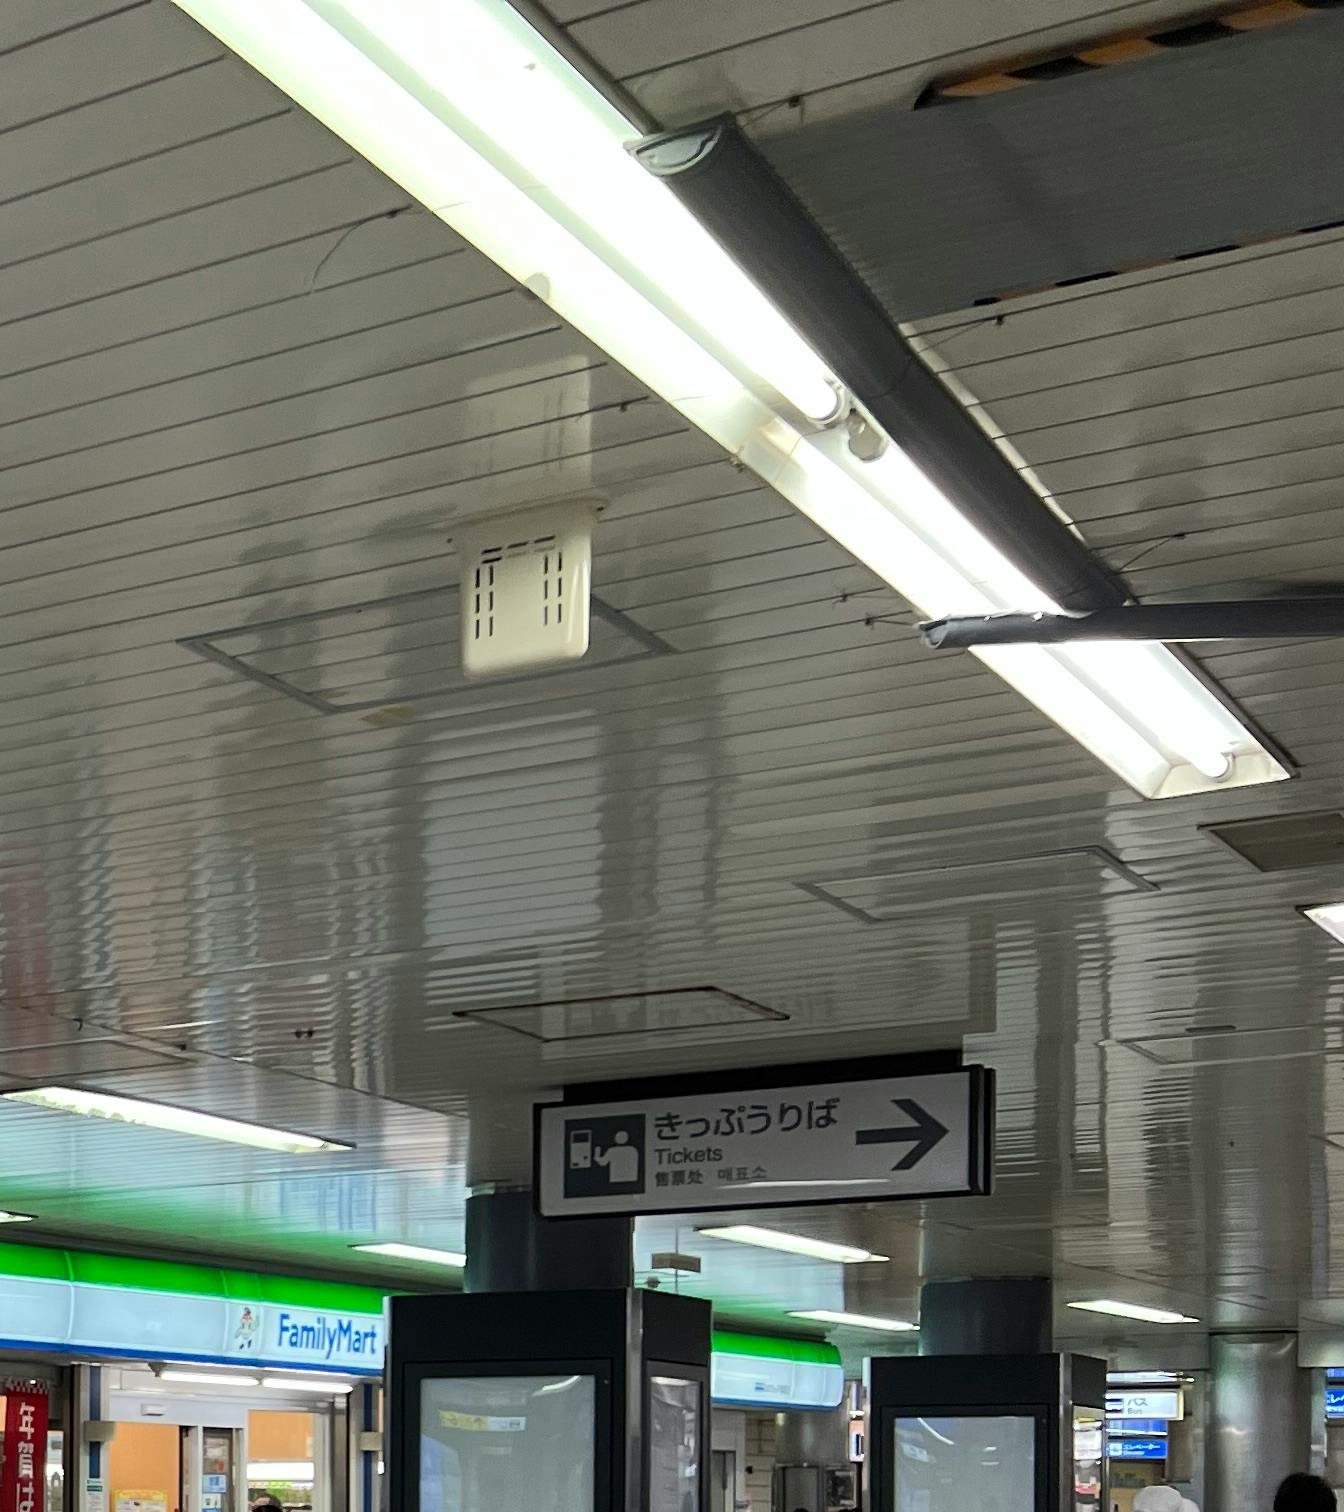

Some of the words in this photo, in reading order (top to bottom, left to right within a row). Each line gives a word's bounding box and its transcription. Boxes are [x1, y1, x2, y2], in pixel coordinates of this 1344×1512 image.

[654, 1097, 841, 1141] きっぷうりば
[654, 1147, 723, 1165] Tickets
[717, 1166, 768, 1181] 매표소
[277, 1313, 377, 1360] FamilyMart
